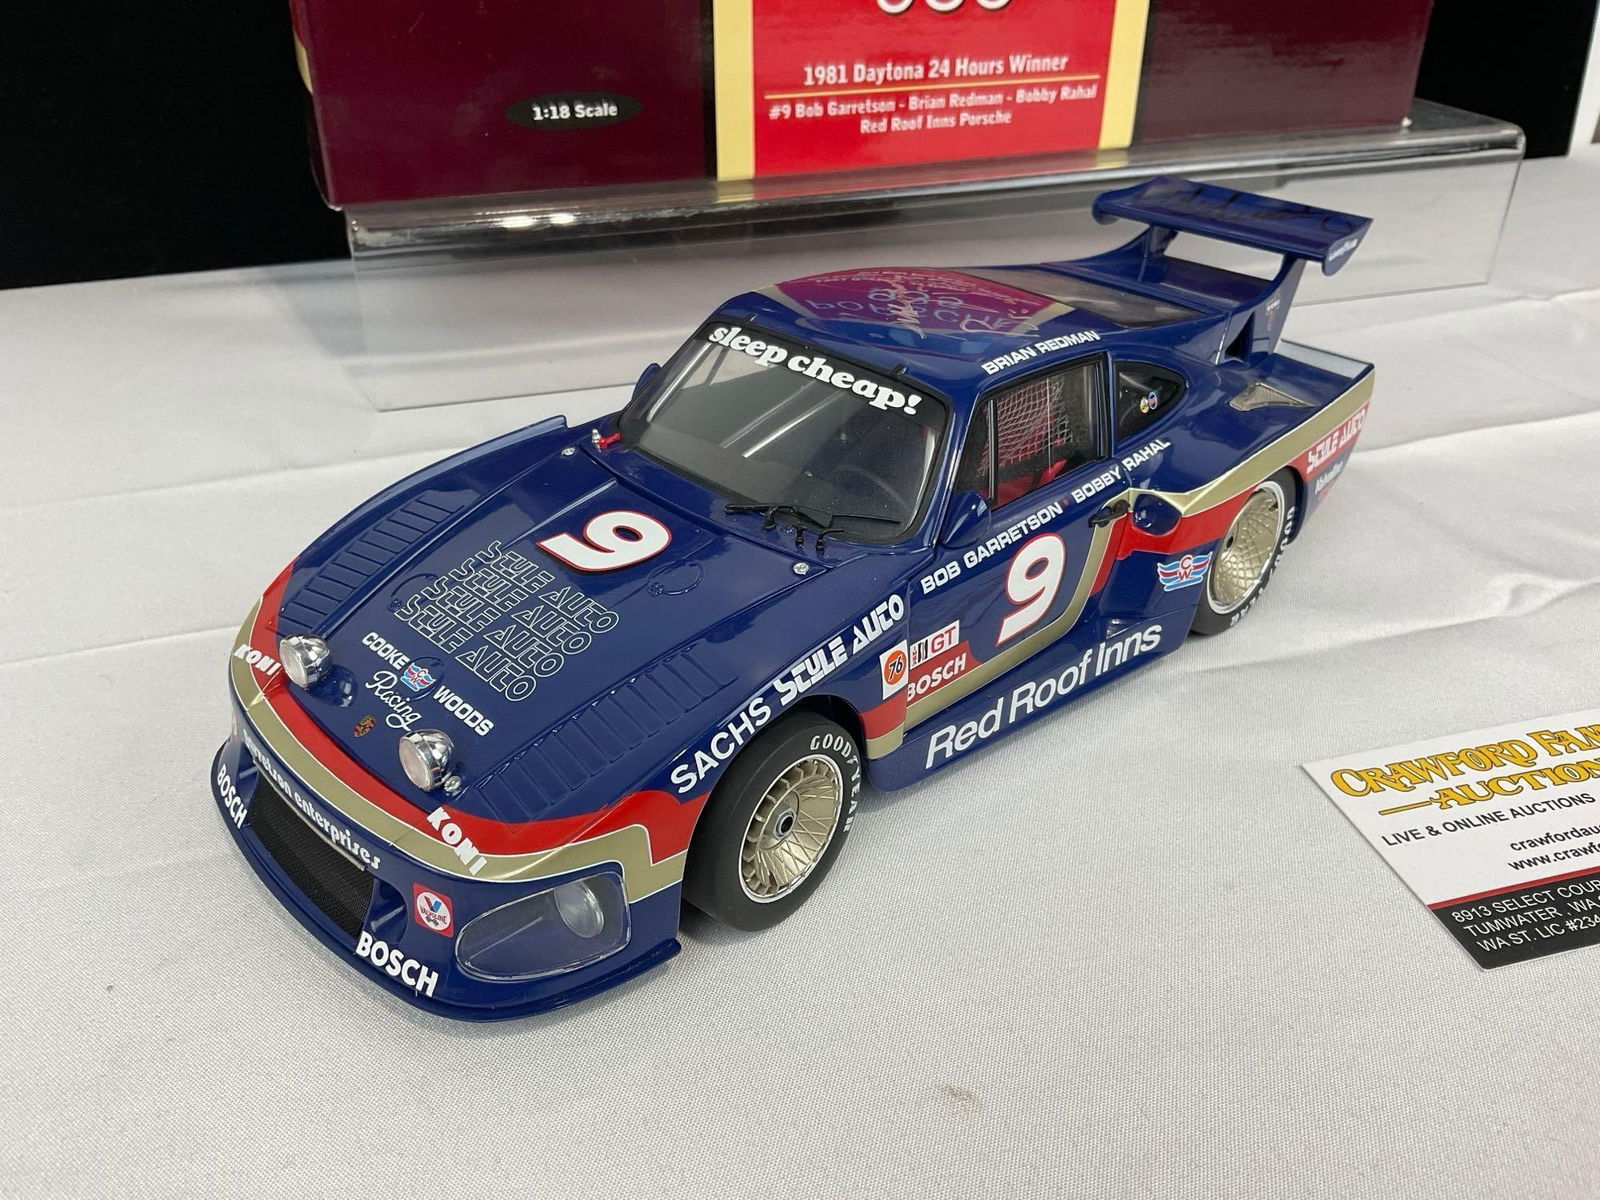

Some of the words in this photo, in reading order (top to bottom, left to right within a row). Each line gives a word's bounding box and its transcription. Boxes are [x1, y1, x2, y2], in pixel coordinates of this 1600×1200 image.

[803, 64, 848, 86] 1981
[853, 61, 923, 85] Daytona
[927, 59, 951, 78] 24
[955, 57, 1004, 76] Hours
[1008, 53, 1069, 73] Winner
[532, 104, 571, 121] 1:18
[574, 101, 618, 119] Scale
[769, 101, 792, 120] #9
[795, 99, 824, 118] Bob
[828, 96, 896, 116] Garretson
[908, 92, 946, 111] Brian
[949, 90, 1003, 109] Redman
[1016, 86, 1056, 105] Bobby
[1060, 84, 1098, 102] Rahal
[860, 118, 887, 135] Red
[890, 115, 923, 132] Roof
[926, 114, 956, 130] Inns
[958, 110, 1013, 128] Porsche
[708, 325, 787, 367] sleep
[787, 353, 922, 416] cheap!
[981, 347, 1036, 376] BRIAN
[1038, 330, 1102, 356] REDMAN
[1070, 465, 1122, 504] BOBBY
[1121, 437, 1172, 473] RAHAL
[920, 561, 960, 595] BOB
[962, 501, 1064, 568] GARRETSON
[996, 532, 1066, 646] 9
[232, 643, 282, 676] KONI
[361, 630, 411, 672] COOKE
[931, 626, 957, 655] GT
[669, 697, 772, 795] SACHS
[851, 593, 905, 655] AUTO
[887, 654, 904, 683] 76
[906, 652, 968, 702] BOSCH
[365, 669, 423, 733] Racing
[433, 685, 495, 737] WOODS
[925, 696, 1005, 770] Red
[1008, 649, 1092, 724] Roof
[1095, 623, 1163, 678] Inns
[809, 733, 860, 832] GOODYEAR
[1330, 739, 1538, 798] CRAWFORD
[217, 764, 248, 830] BOSCH
[1381, 828, 1425, 847] LIVE
[1426, 824, 1441, 837] &
[1442, 809, 1510, 834] ONLINE
[1509, 793, 1597, 819] AUCTIONS
[295, 790, 381, 869] enterprises
[427, 806, 488, 876] KONI
[1510, 823, 1600, 851] crawfordau
[1451, 905, 1492, 923] 8913
[1492, 890, 1556, 914] SELECT
[1463, 906, 1563, 937] TUMWATER
[1566, 897, 1600, 913] WA
[355, 930, 439, 997] BOSCH
[1476, 936, 1511, 952] WA
[1508, 930, 1537, 945] ST.
[1534, 923, 1566, 939] LIC
